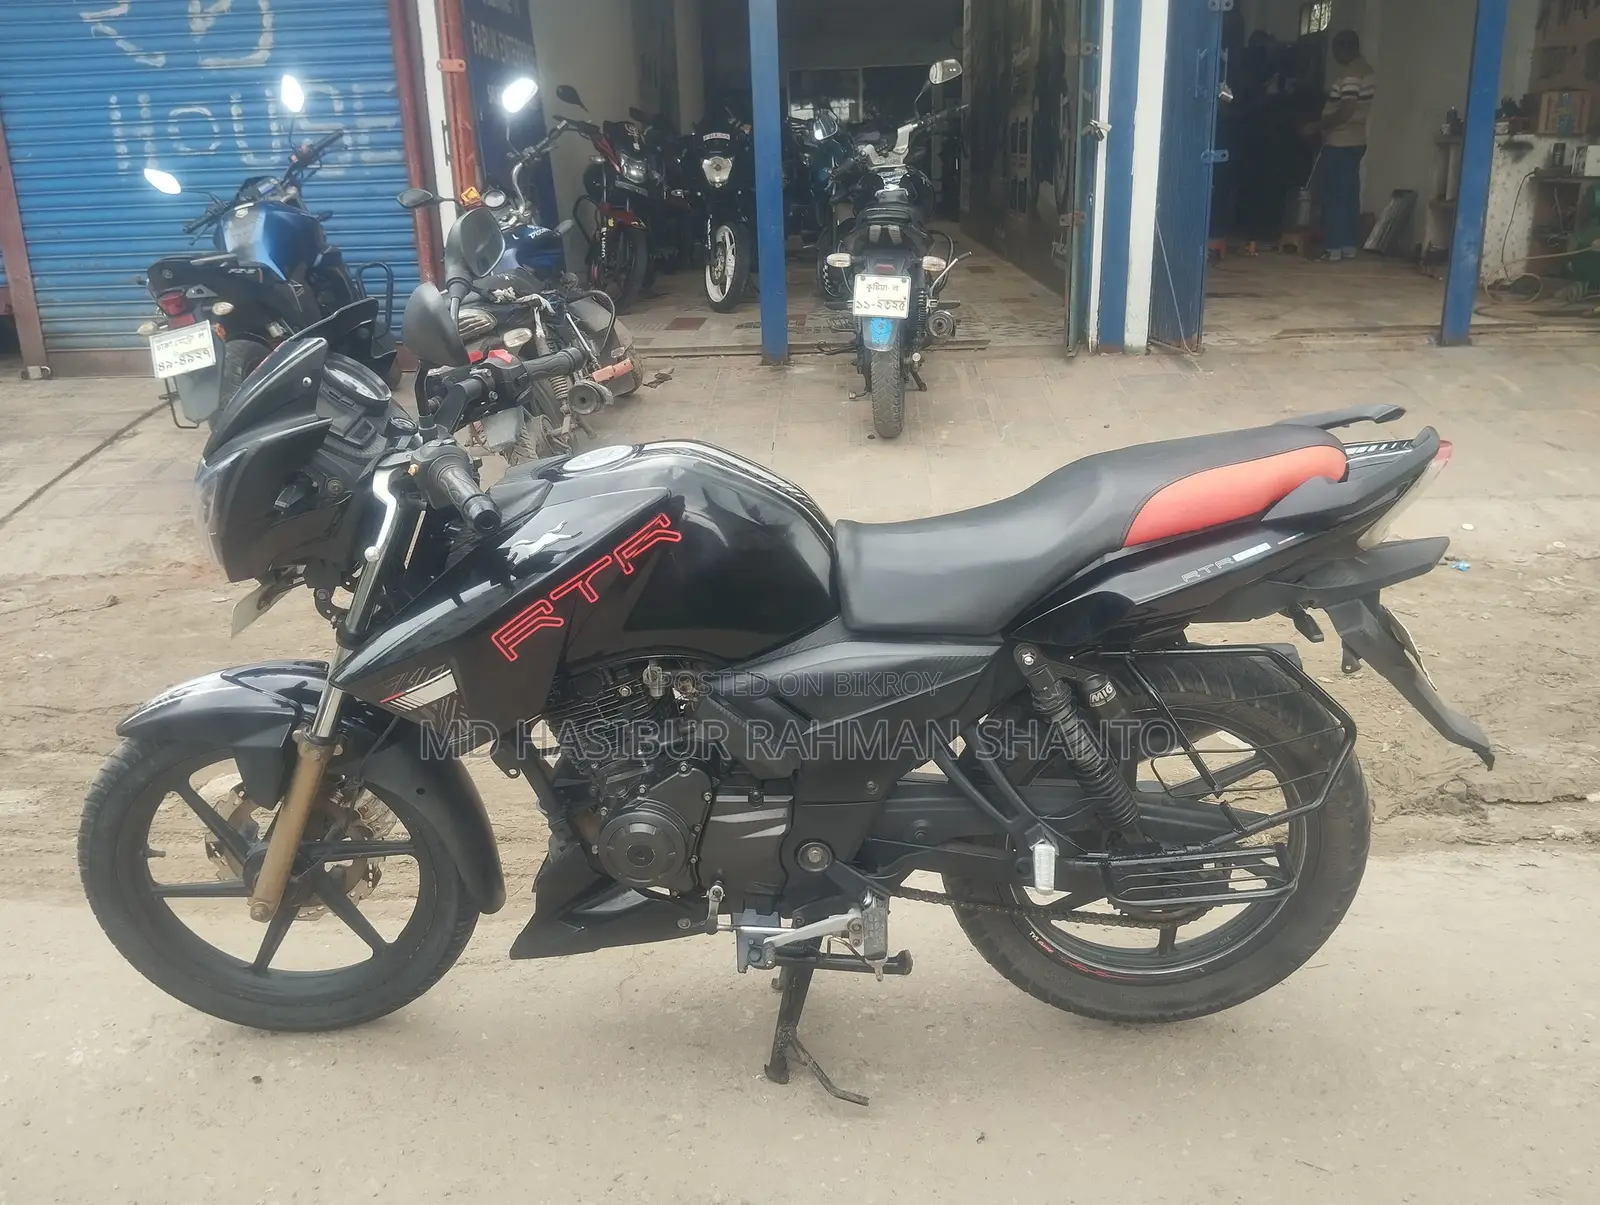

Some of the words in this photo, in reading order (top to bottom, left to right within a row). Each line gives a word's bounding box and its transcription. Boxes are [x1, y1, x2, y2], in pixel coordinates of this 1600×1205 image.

[1181, 557, 1234, 582] RTR
[491, 512, 682, 662] RTR
[1091, 684, 1113, 703] MIG
